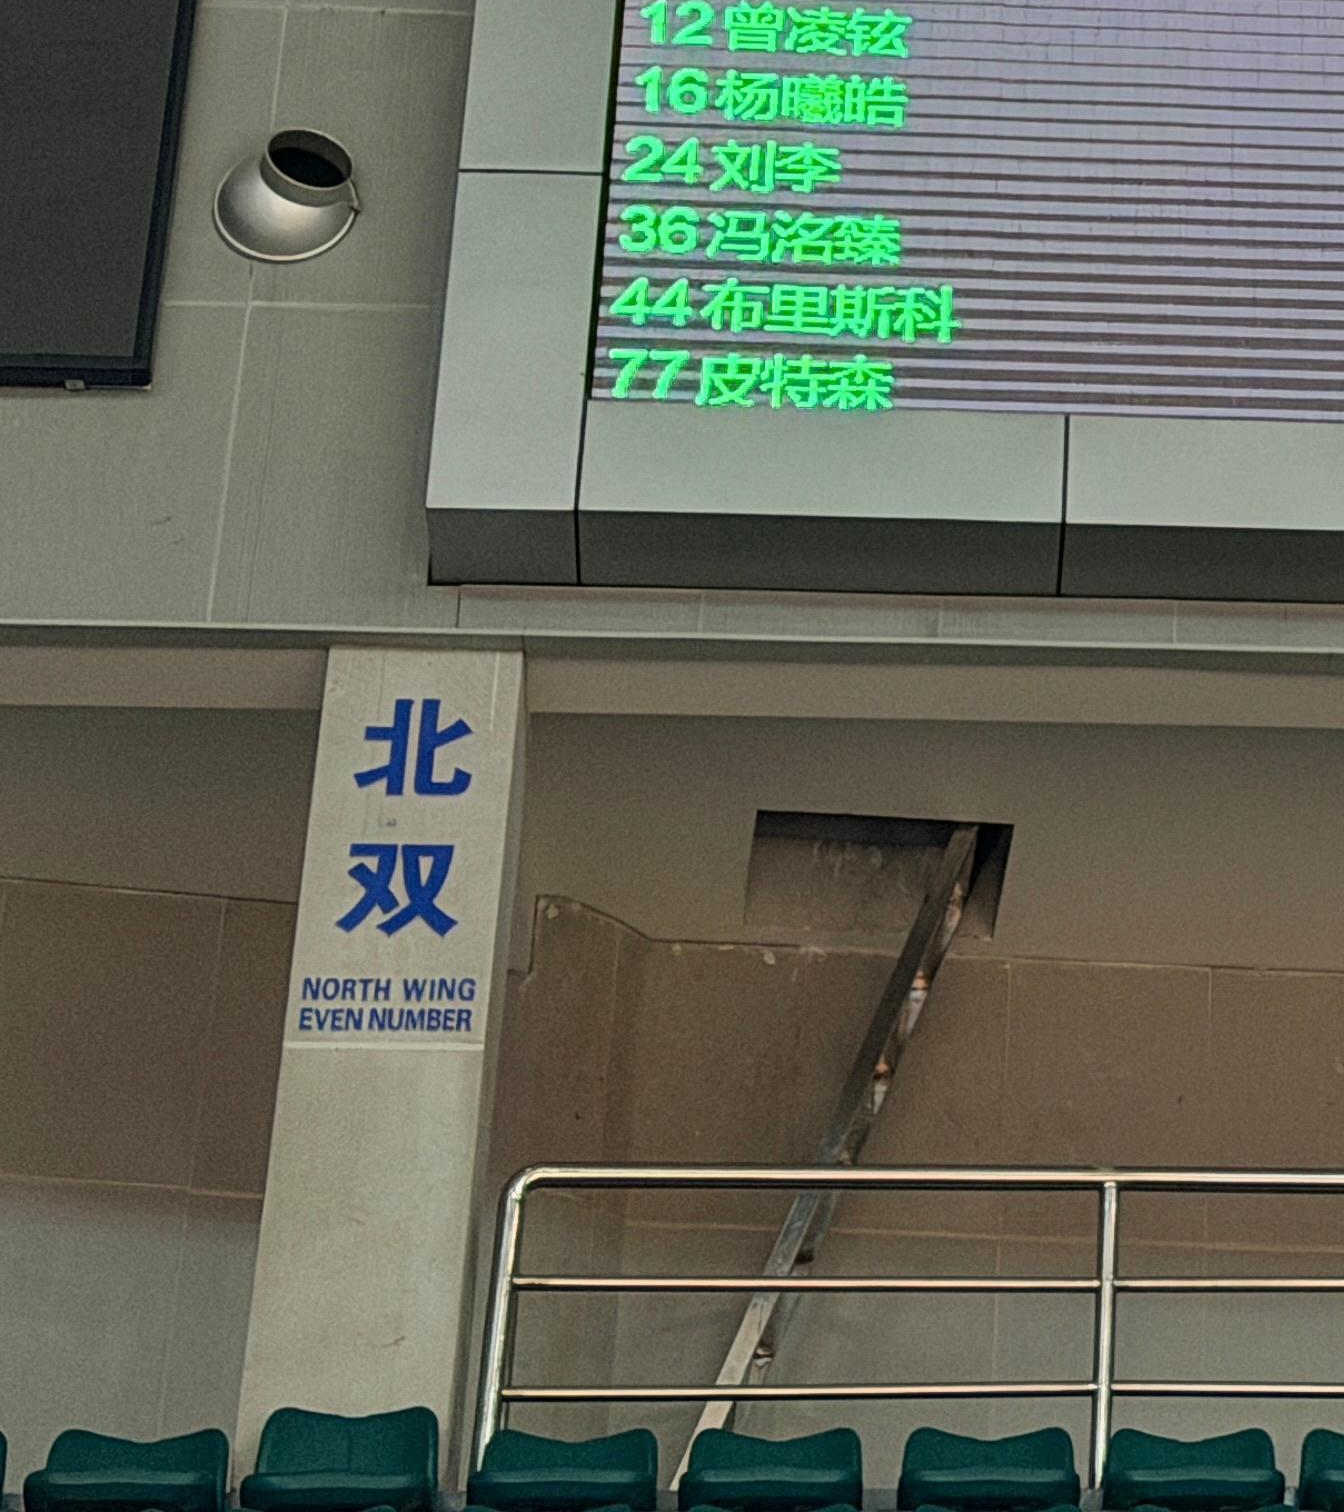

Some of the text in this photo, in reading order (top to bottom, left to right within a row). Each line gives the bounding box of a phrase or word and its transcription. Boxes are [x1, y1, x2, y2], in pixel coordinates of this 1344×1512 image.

[301, 976, 477, 1002] NORTH WING
[299, 1007, 473, 1032] EVEN NUMBER
